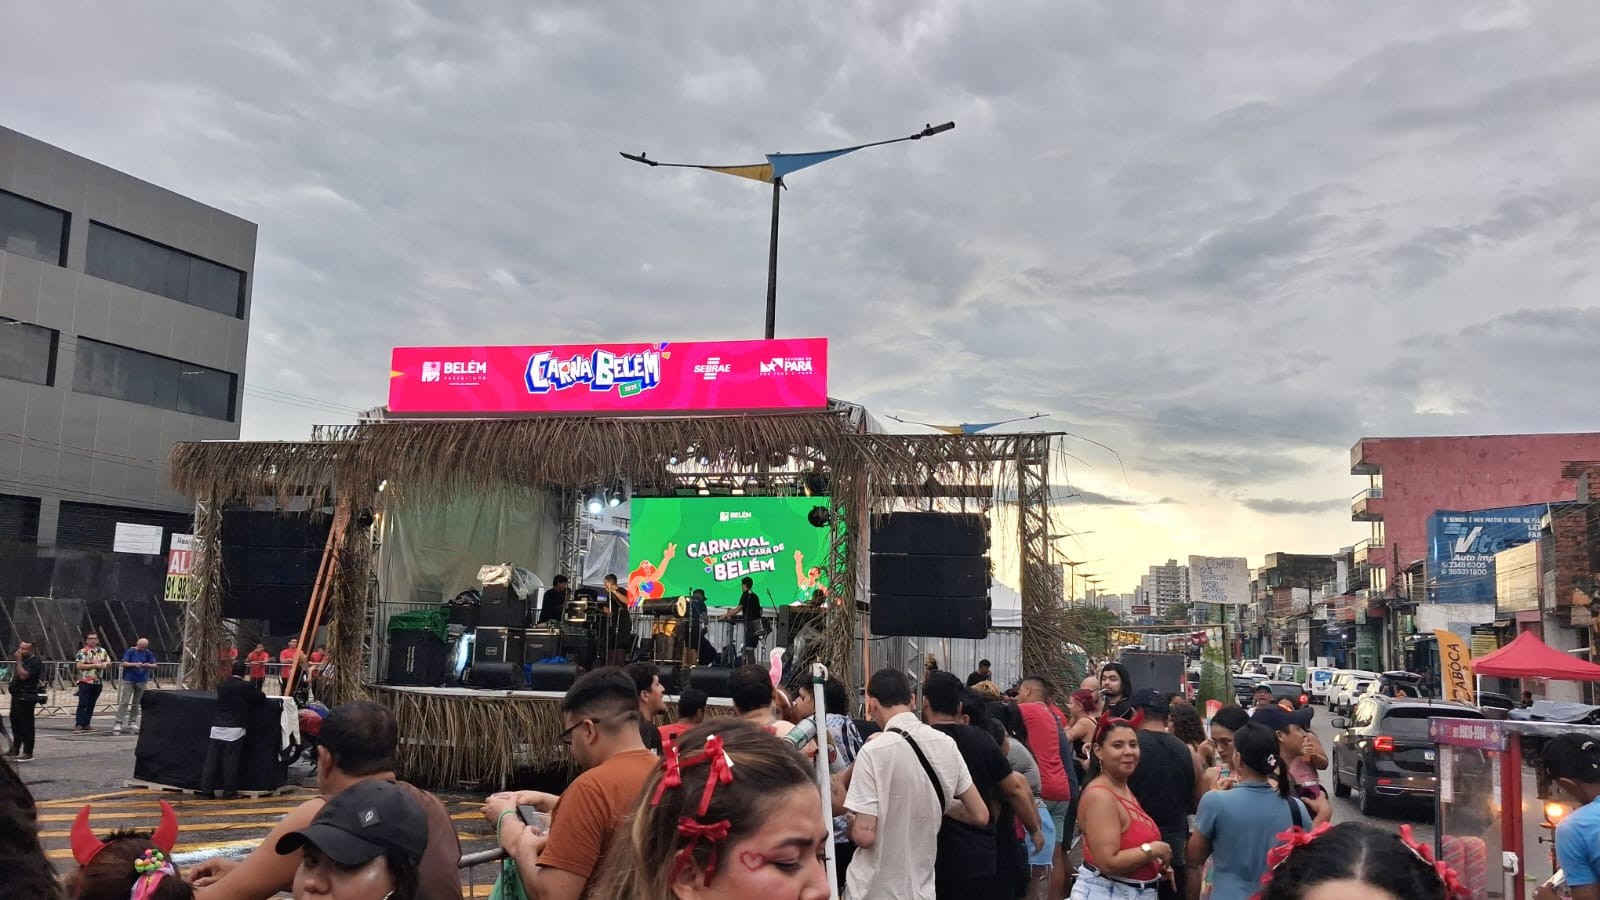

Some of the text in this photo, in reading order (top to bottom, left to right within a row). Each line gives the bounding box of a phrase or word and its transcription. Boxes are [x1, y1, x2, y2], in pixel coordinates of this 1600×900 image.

[444, 360, 487, 374] BELÉM
[693, 364, 732, 373] SEBRAE
[687, 536, 769, 558] CARNAVAL
[721, 543, 785, 563] COM A CARA DE
[1452, 554, 1476, 562] Auto
[713, 557, 776, 582] BELÉM
